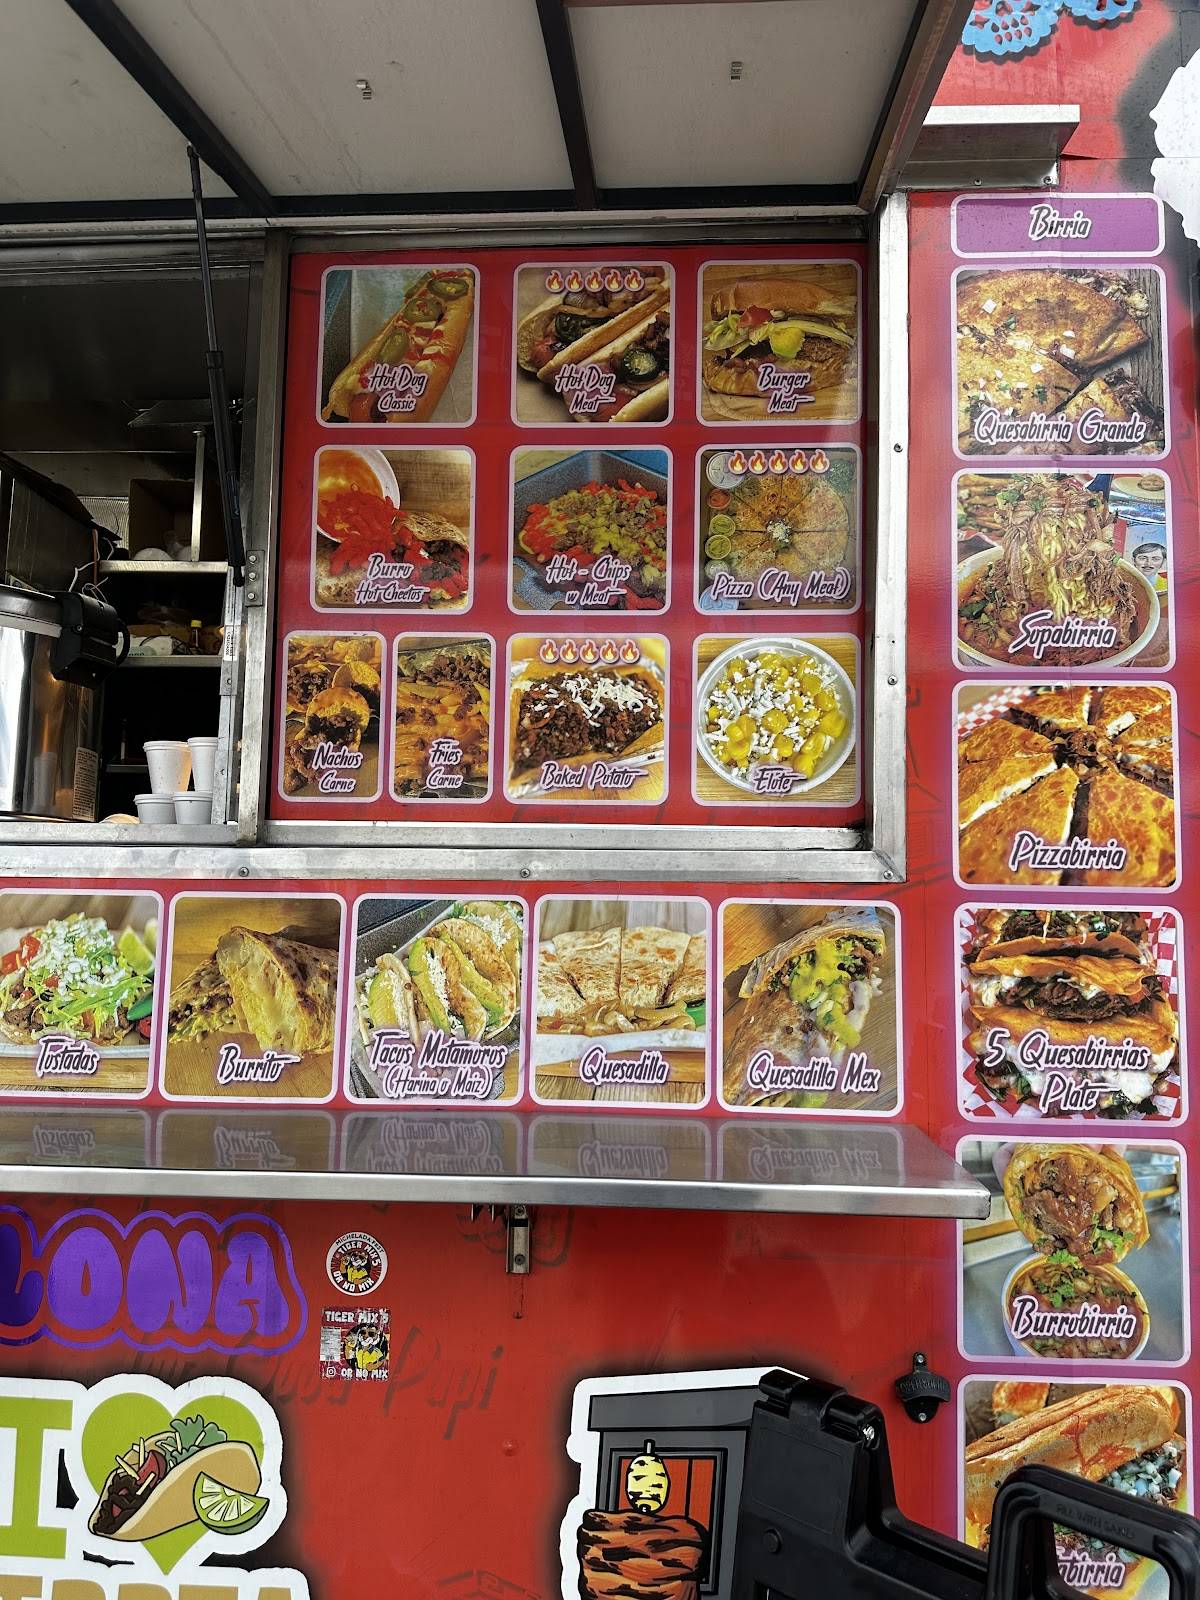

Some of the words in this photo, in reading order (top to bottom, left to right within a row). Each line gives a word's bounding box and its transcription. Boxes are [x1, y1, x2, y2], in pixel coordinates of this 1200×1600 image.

[1028, 204, 1092, 241] Birria
[758, 364, 811, 395] Burger
[378, 391, 416, 412] Classic
[570, 392, 616, 413] Meat
[768, 393, 815, 413] Meat
[975, 408, 1072, 446] Quesabirria
[1077, 410, 1147, 445] Grande
[368, 553, 414, 579] Burro
[546, 555, 577, 583] Hot
[592, 555, 632, 588] Chips
[355, 581, 383, 604] Hot
[382, 581, 430, 603] Cheetos
[580, 583, 628, 605] Meat
[711, 572, 754, 600] Pizza
[758, 567, 801, 606] (Any
[804, 567, 851, 600] Meat)
[312, 742, 363, 770] Nachos
[428, 738, 463, 765] Fries
[318, 770, 356, 793] Carne
[426, 767, 463, 789] Carne
[540, 761, 587, 789] Baked
[588, 761, 650, 790] Potato
[752, 765, 808, 794] Elote
[1009, 831, 1126, 872] Pizzabirria
[36, 1036, 99, 1077] Tostadas
[217, 1043, 300, 1084] Burrito
[370, 1029, 415, 1071] Tacos
[419, 1030, 510, 1069] Matamoros
[984, 1030, 1011, 1067] 5
[1019, 1030, 1150, 1072] Quesabirrias
[579, 1045, 670, 1085] Quesadilla
[746, 1050, 838, 1091] Quesadilla
[840, 1053, 882, 1093] Mex
[383, 1066, 438, 1098] (Harina
[1038, 1073, 1122, 1115] Plate
[338, 1241, 363, 1254] TIGER
[342, 1281, 356, 1292] NO
[358, 1277, 375, 1292] MIX
[324, 1310, 355, 1323] TIGER
[357, 1309, 379, 1324] MIX
[1010, 1294, 1137, 1339] Burrobirria
[341, 1367, 353, 1378] OR
[355, 1368, 368, 1380] NO
[370, 1369, 389, 1380] MIX
